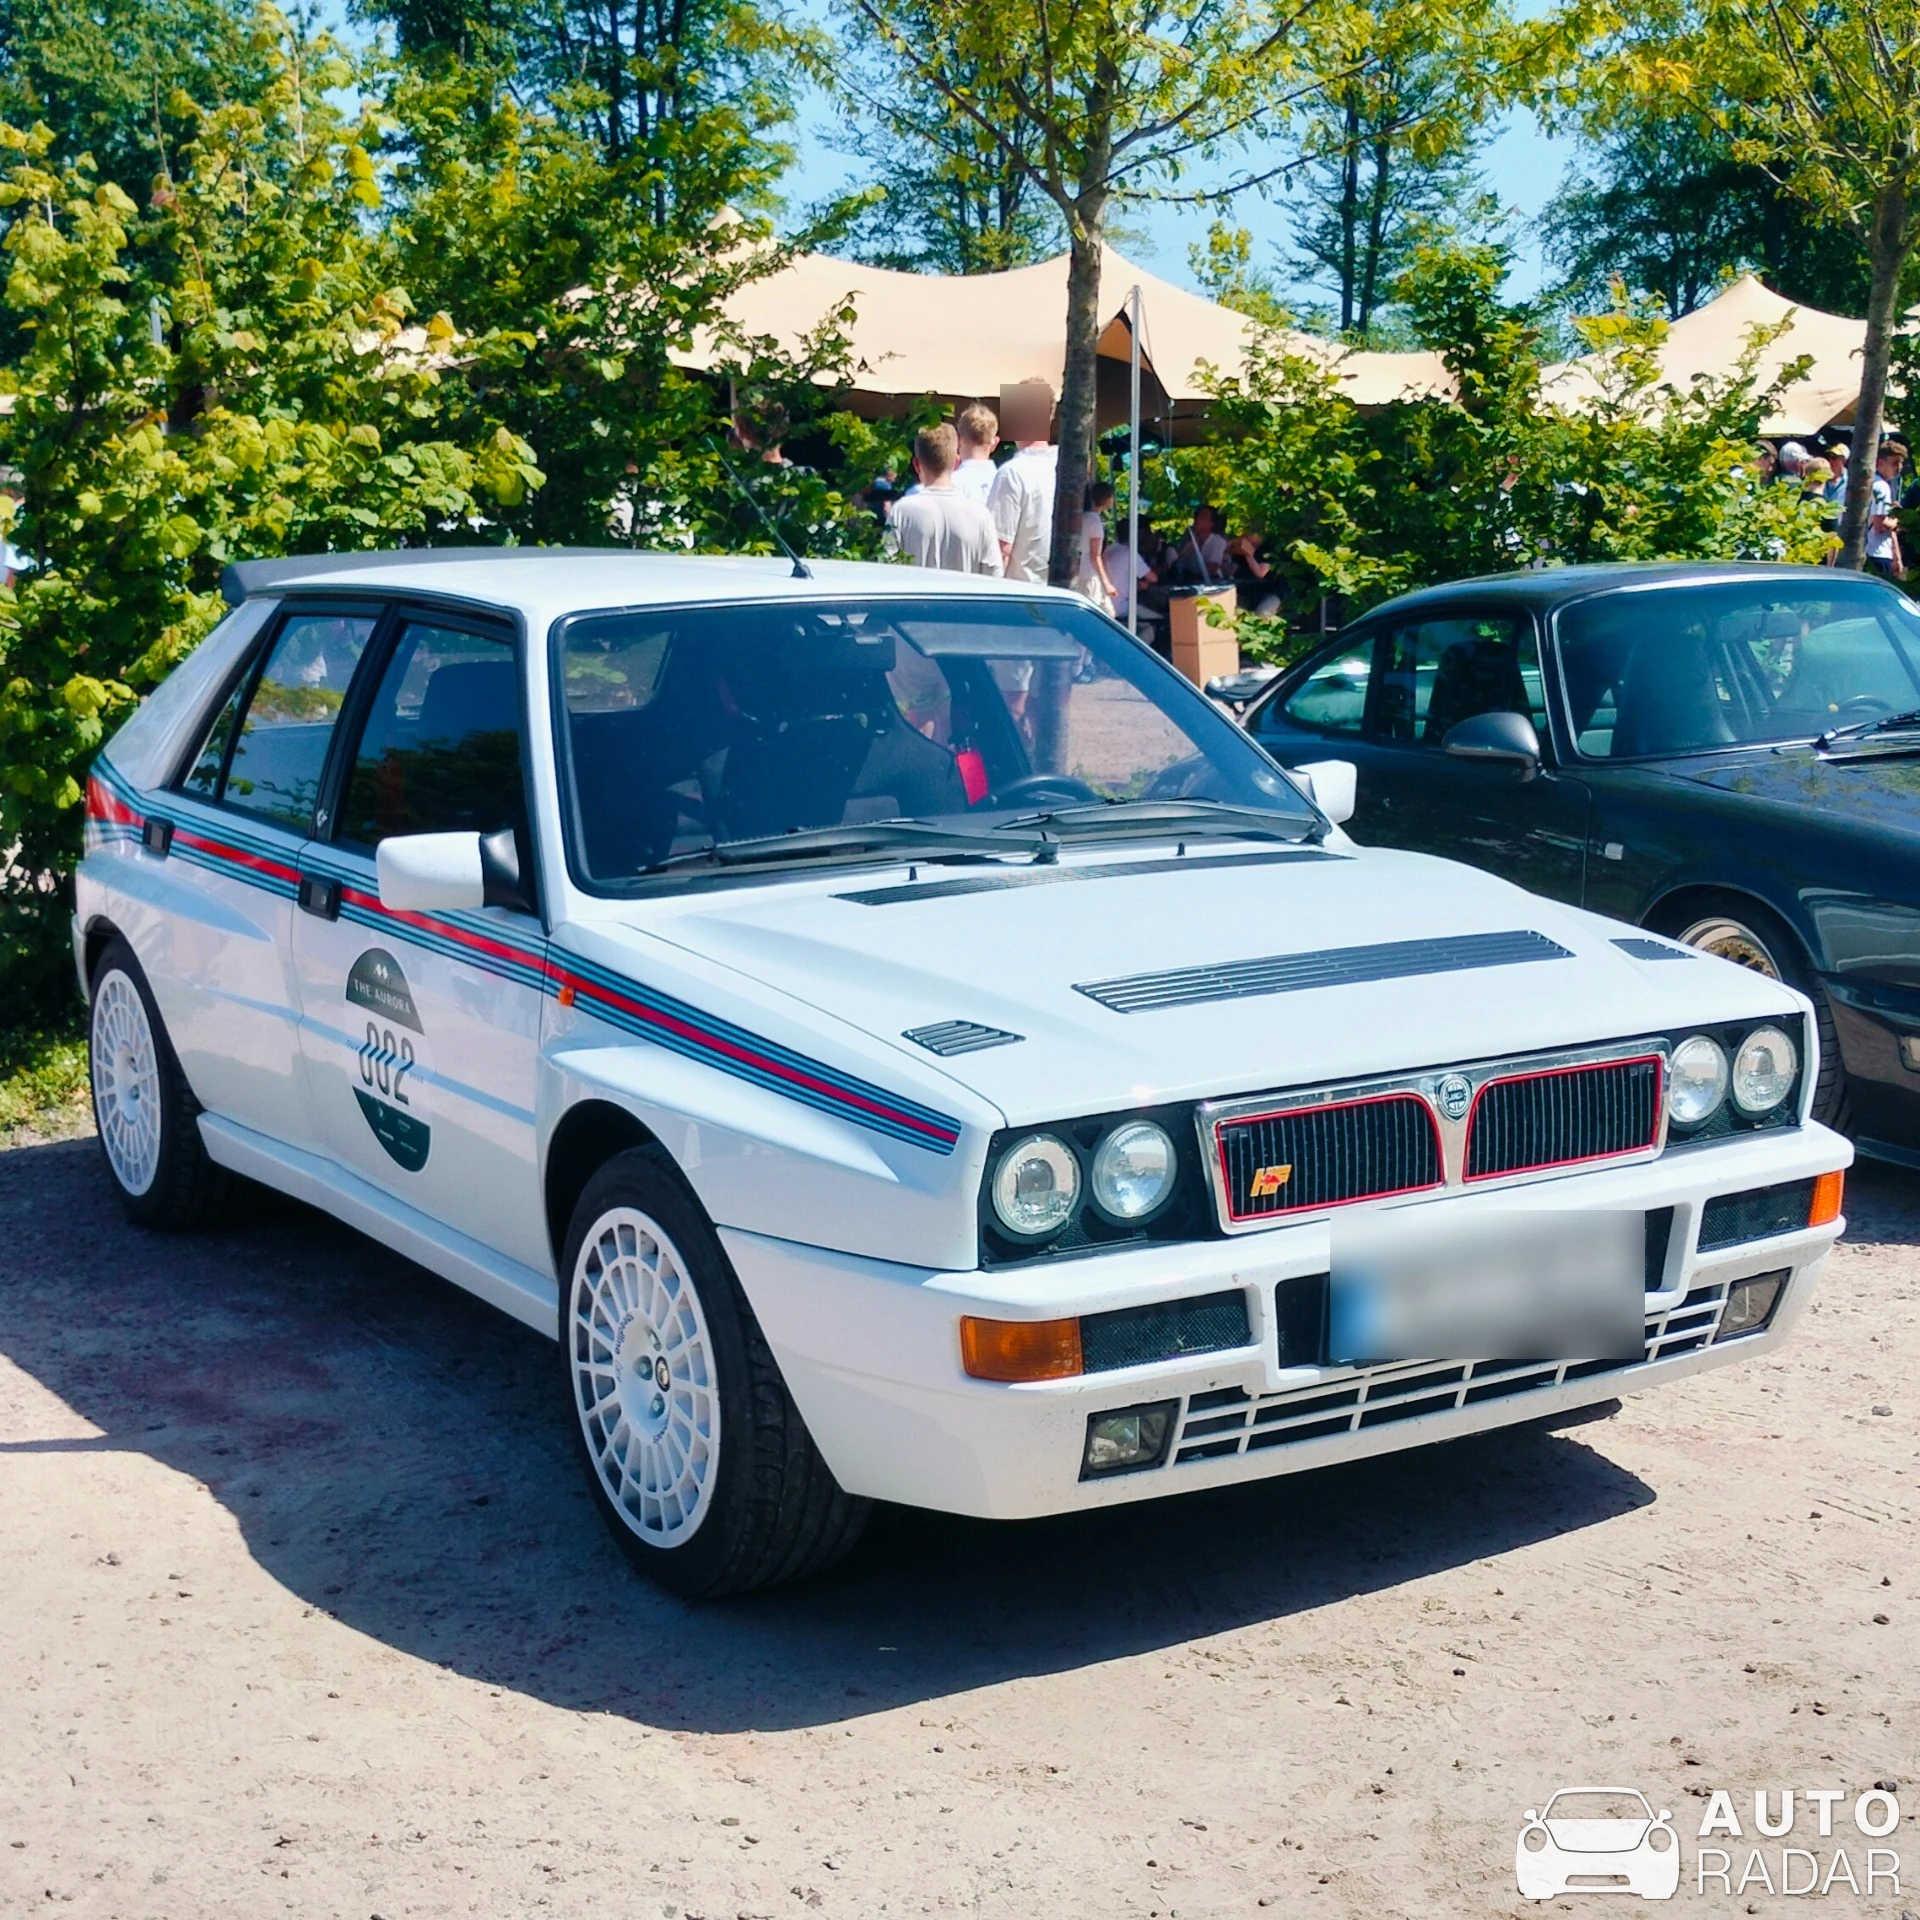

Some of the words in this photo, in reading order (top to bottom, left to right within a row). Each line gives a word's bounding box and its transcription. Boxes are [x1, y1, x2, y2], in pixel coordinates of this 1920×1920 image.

[354, 978, 371, 998] THE
[375, 988, 411, 1014] AURORA
[359, 1021, 415, 1106] 002
[1250, 1164, 1292, 1197] HF
